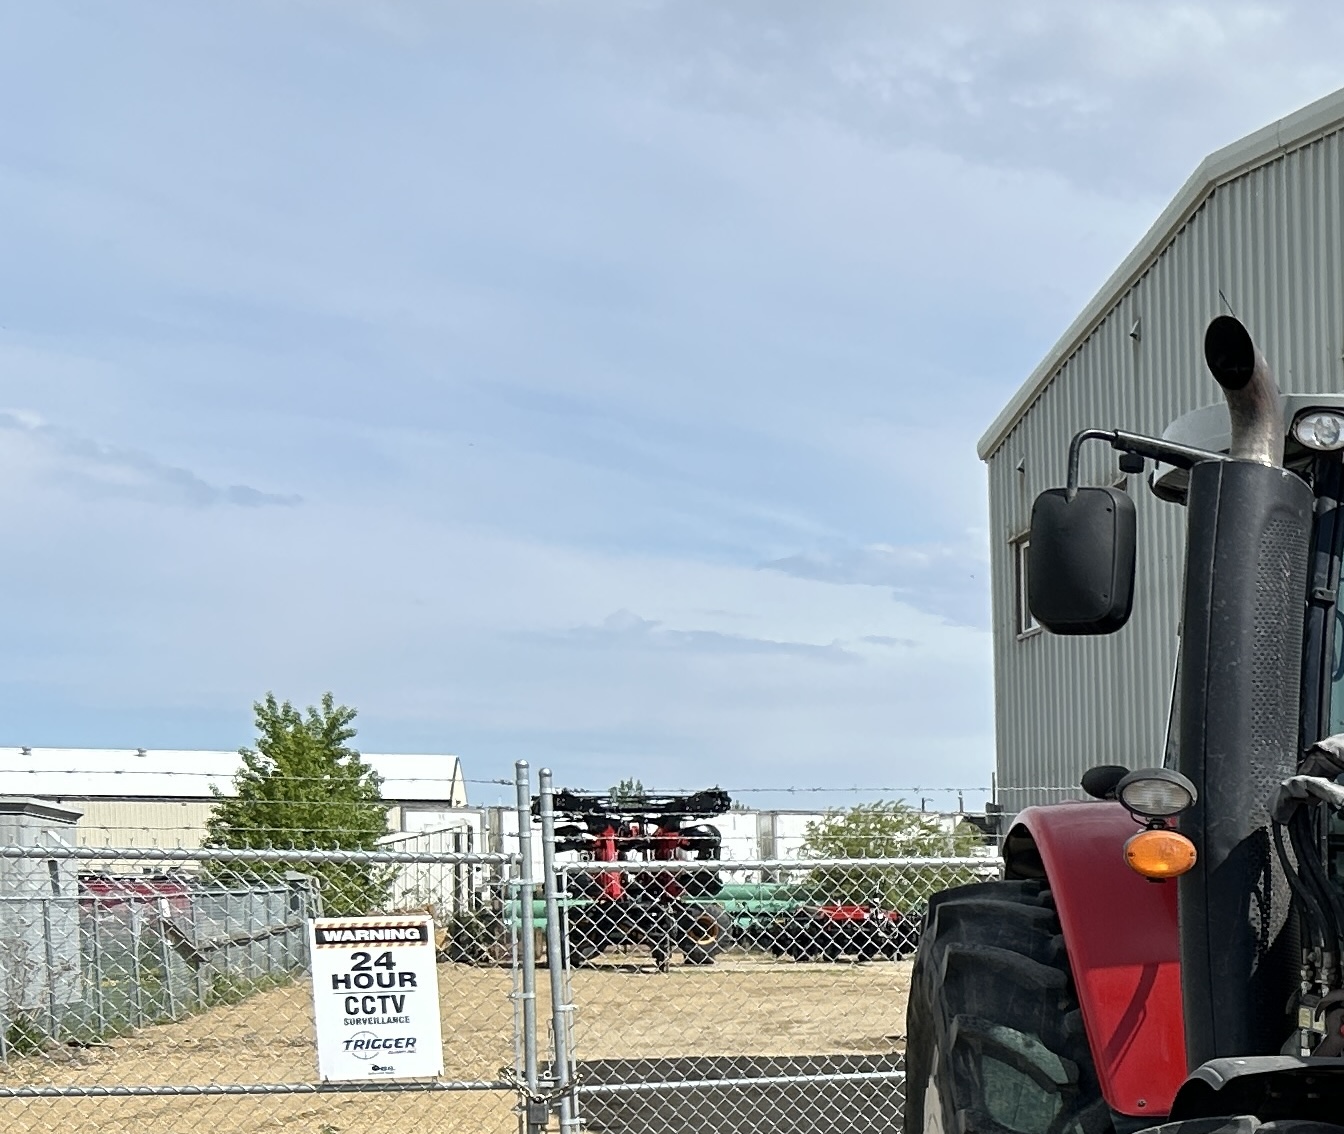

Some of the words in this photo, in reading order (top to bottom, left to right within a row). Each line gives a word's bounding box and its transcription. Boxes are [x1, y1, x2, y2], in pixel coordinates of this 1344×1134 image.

[322, 928, 421, 942] WARNING
[350, 951, 396, 972] 24
[331, 971, 418, 990] HOUR
[344, 994, 406, 1015] CCTV
[343, 1015, 411, 1026] SURVEILLANCE
[342, 1037, 417, 1051] TRIGGER
